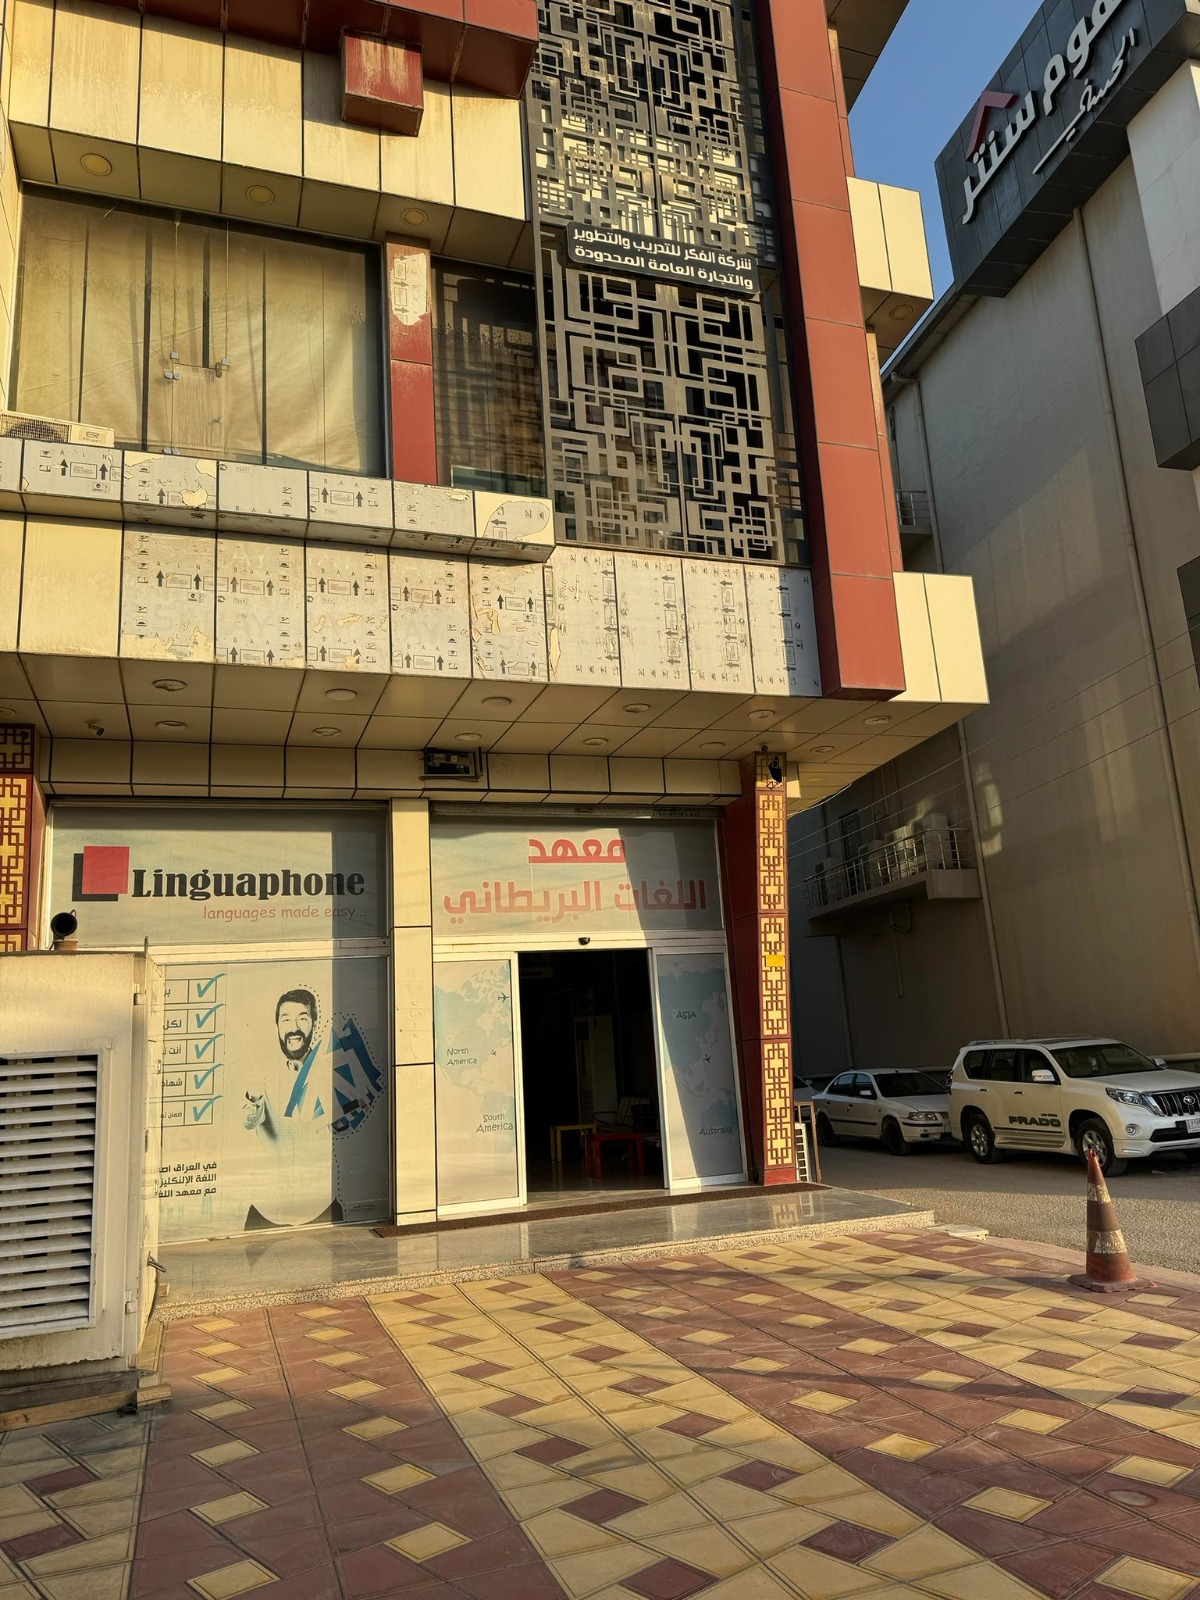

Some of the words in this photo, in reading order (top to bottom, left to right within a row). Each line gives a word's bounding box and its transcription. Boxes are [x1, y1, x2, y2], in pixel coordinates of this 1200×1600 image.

[962, 90, 1036, 225] سنتر
[573, 228, 630, 250] والتطوير
[633, 240, 681, 257] للتدريب
[575, 245, 645, 268] المحدودة
[684, 248, 715, 264] الفكر
[718, 255, 752, 271] شركة
[648, 258, 695, 277] العامة
[698, 268, 753, 290] والتجارة
[528, 838, 626, 864] معهد
[131, 868, 365, 901] Linguaphone
[614, 879, 707, 911] اللغات
[443, 880, 602, 925] البريطاني
[203, 905, 276, 923] languages
[281, 905, 319, 918] made
[676, 1010, 697, 1019] ASIA
[163, 1019, 182, 1031] لكل
[447, 1047, 469, 1056] North
[447, 1056, 477, 1066] America
[483, 1112, 505, 1123] South
[1008, 1115, 1061, 1128] PRADO
[476, 1122, 513, 1134] America
[699, 1126, 733, 1136] Australia
[173, 1162, 200, 1174] العراق
[202, 1161, 217, 1171] في
[195, 1173, 217, 1182] اللغة
[175, 1188, 202, 1197] معهد
[203, 1187, 217, 1197] مع
